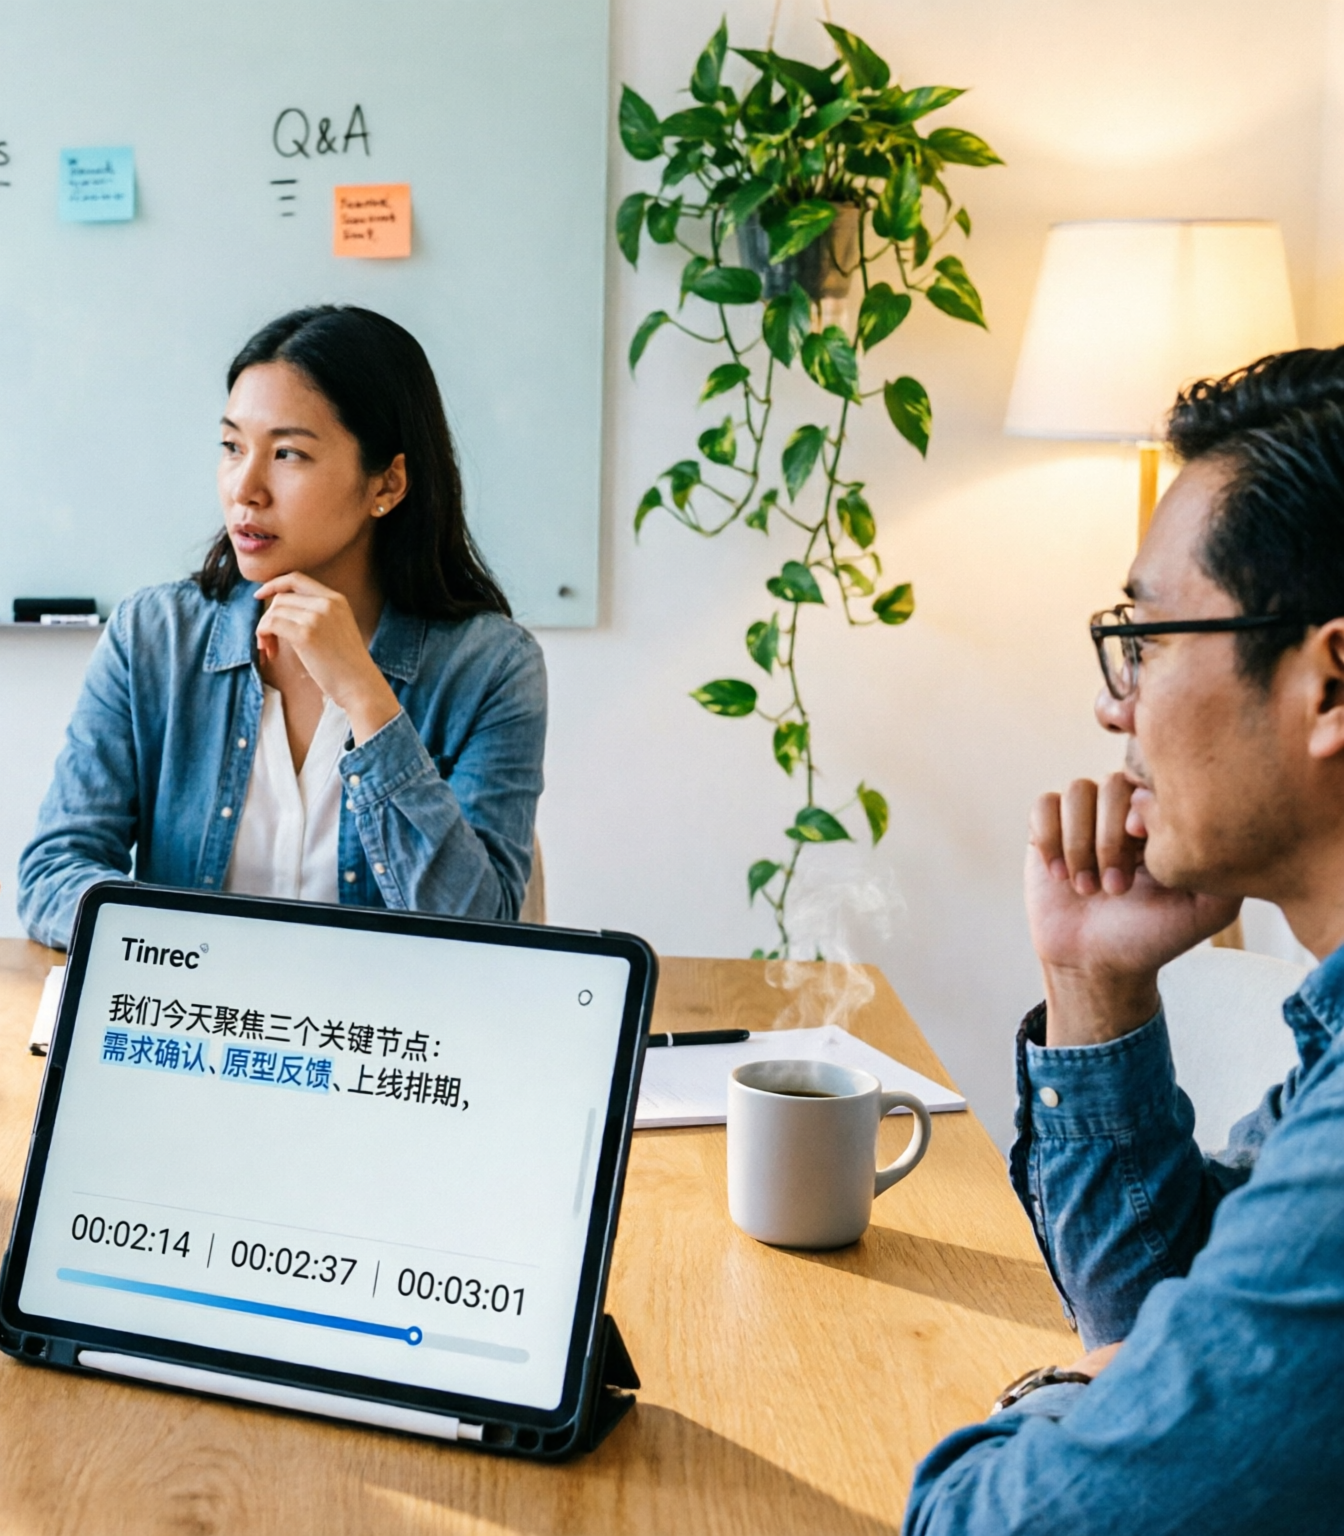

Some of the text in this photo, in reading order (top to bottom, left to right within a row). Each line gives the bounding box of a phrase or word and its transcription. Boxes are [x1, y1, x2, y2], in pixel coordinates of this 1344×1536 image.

[273, 103, 370, 159] Q&A
[121, 936, 200, 970] Tinrec
[108, 993, 441, 1063] 我们今天聚焦三个关键节点：
[71, 1213, 525, 1316] 00:02:14 00:02:37 00:03:01
